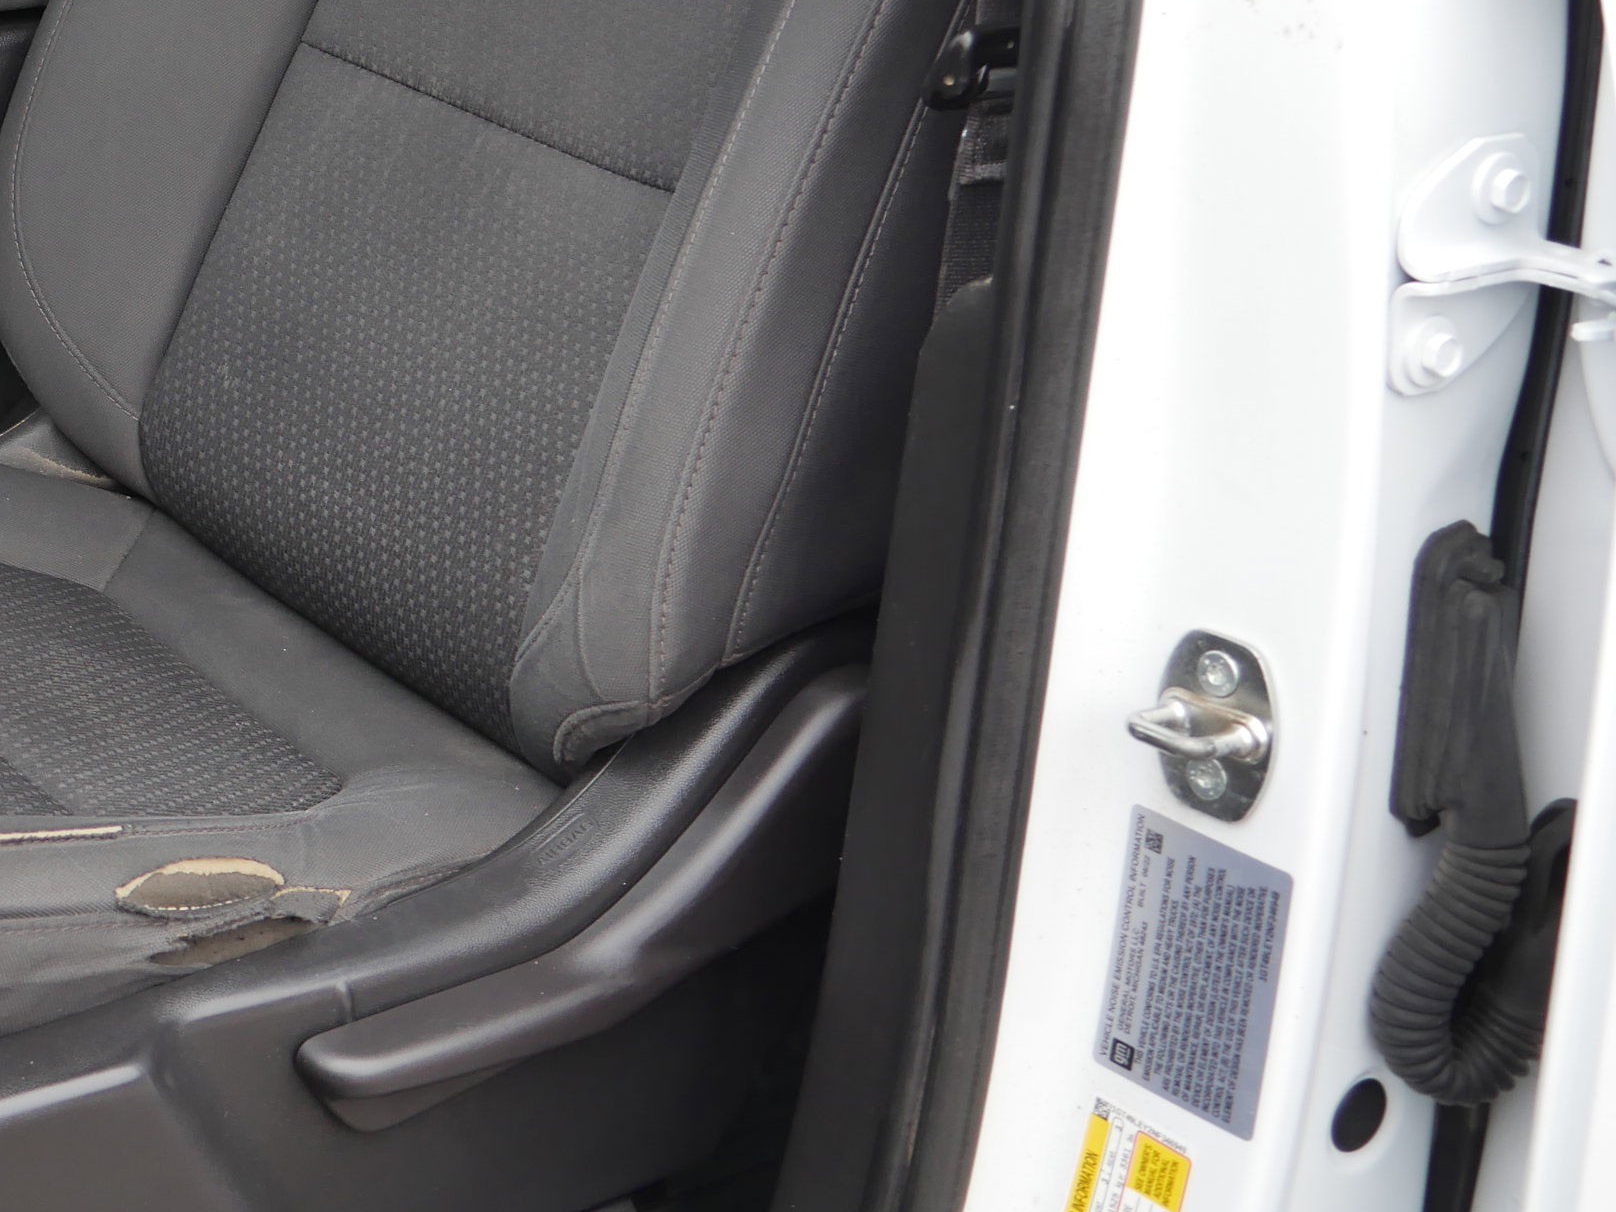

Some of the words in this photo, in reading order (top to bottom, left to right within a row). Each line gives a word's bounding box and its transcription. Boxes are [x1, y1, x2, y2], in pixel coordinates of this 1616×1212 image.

[537, 818, 594, 866] AIRBAG
[1137, 883, 1146, 908] BUILT
[1100, 1017, 1114, 1055] VEHICLE
[1108, 983, 1119, 1013] NOISE
[1114, 933, 1127, 980] EMISSION
[1122, 886, 1134, 931] CONTROL
[1130, 814, 1145, 881] INFORMATION
[1118, 991, 1129, 1030] GENERAL
[1125, 948, 1136, 986] MOTORS
[1132, 928, 1140, 946] LLC
[1131, 949, 1144, 992] MICHIGAN
[1139, 1146, 1151, 1176] OWNER'S
[1144, 1169, 1157, 1195] MANUAL
[1151, 1150, 1160, 1166] FOR
[1154, 1161, 1169, 1198] ADDITIONAL
[1135, 1178, 1144, 1191] SEE
[1163, 1162, 1178, 1206] INFORMATION
